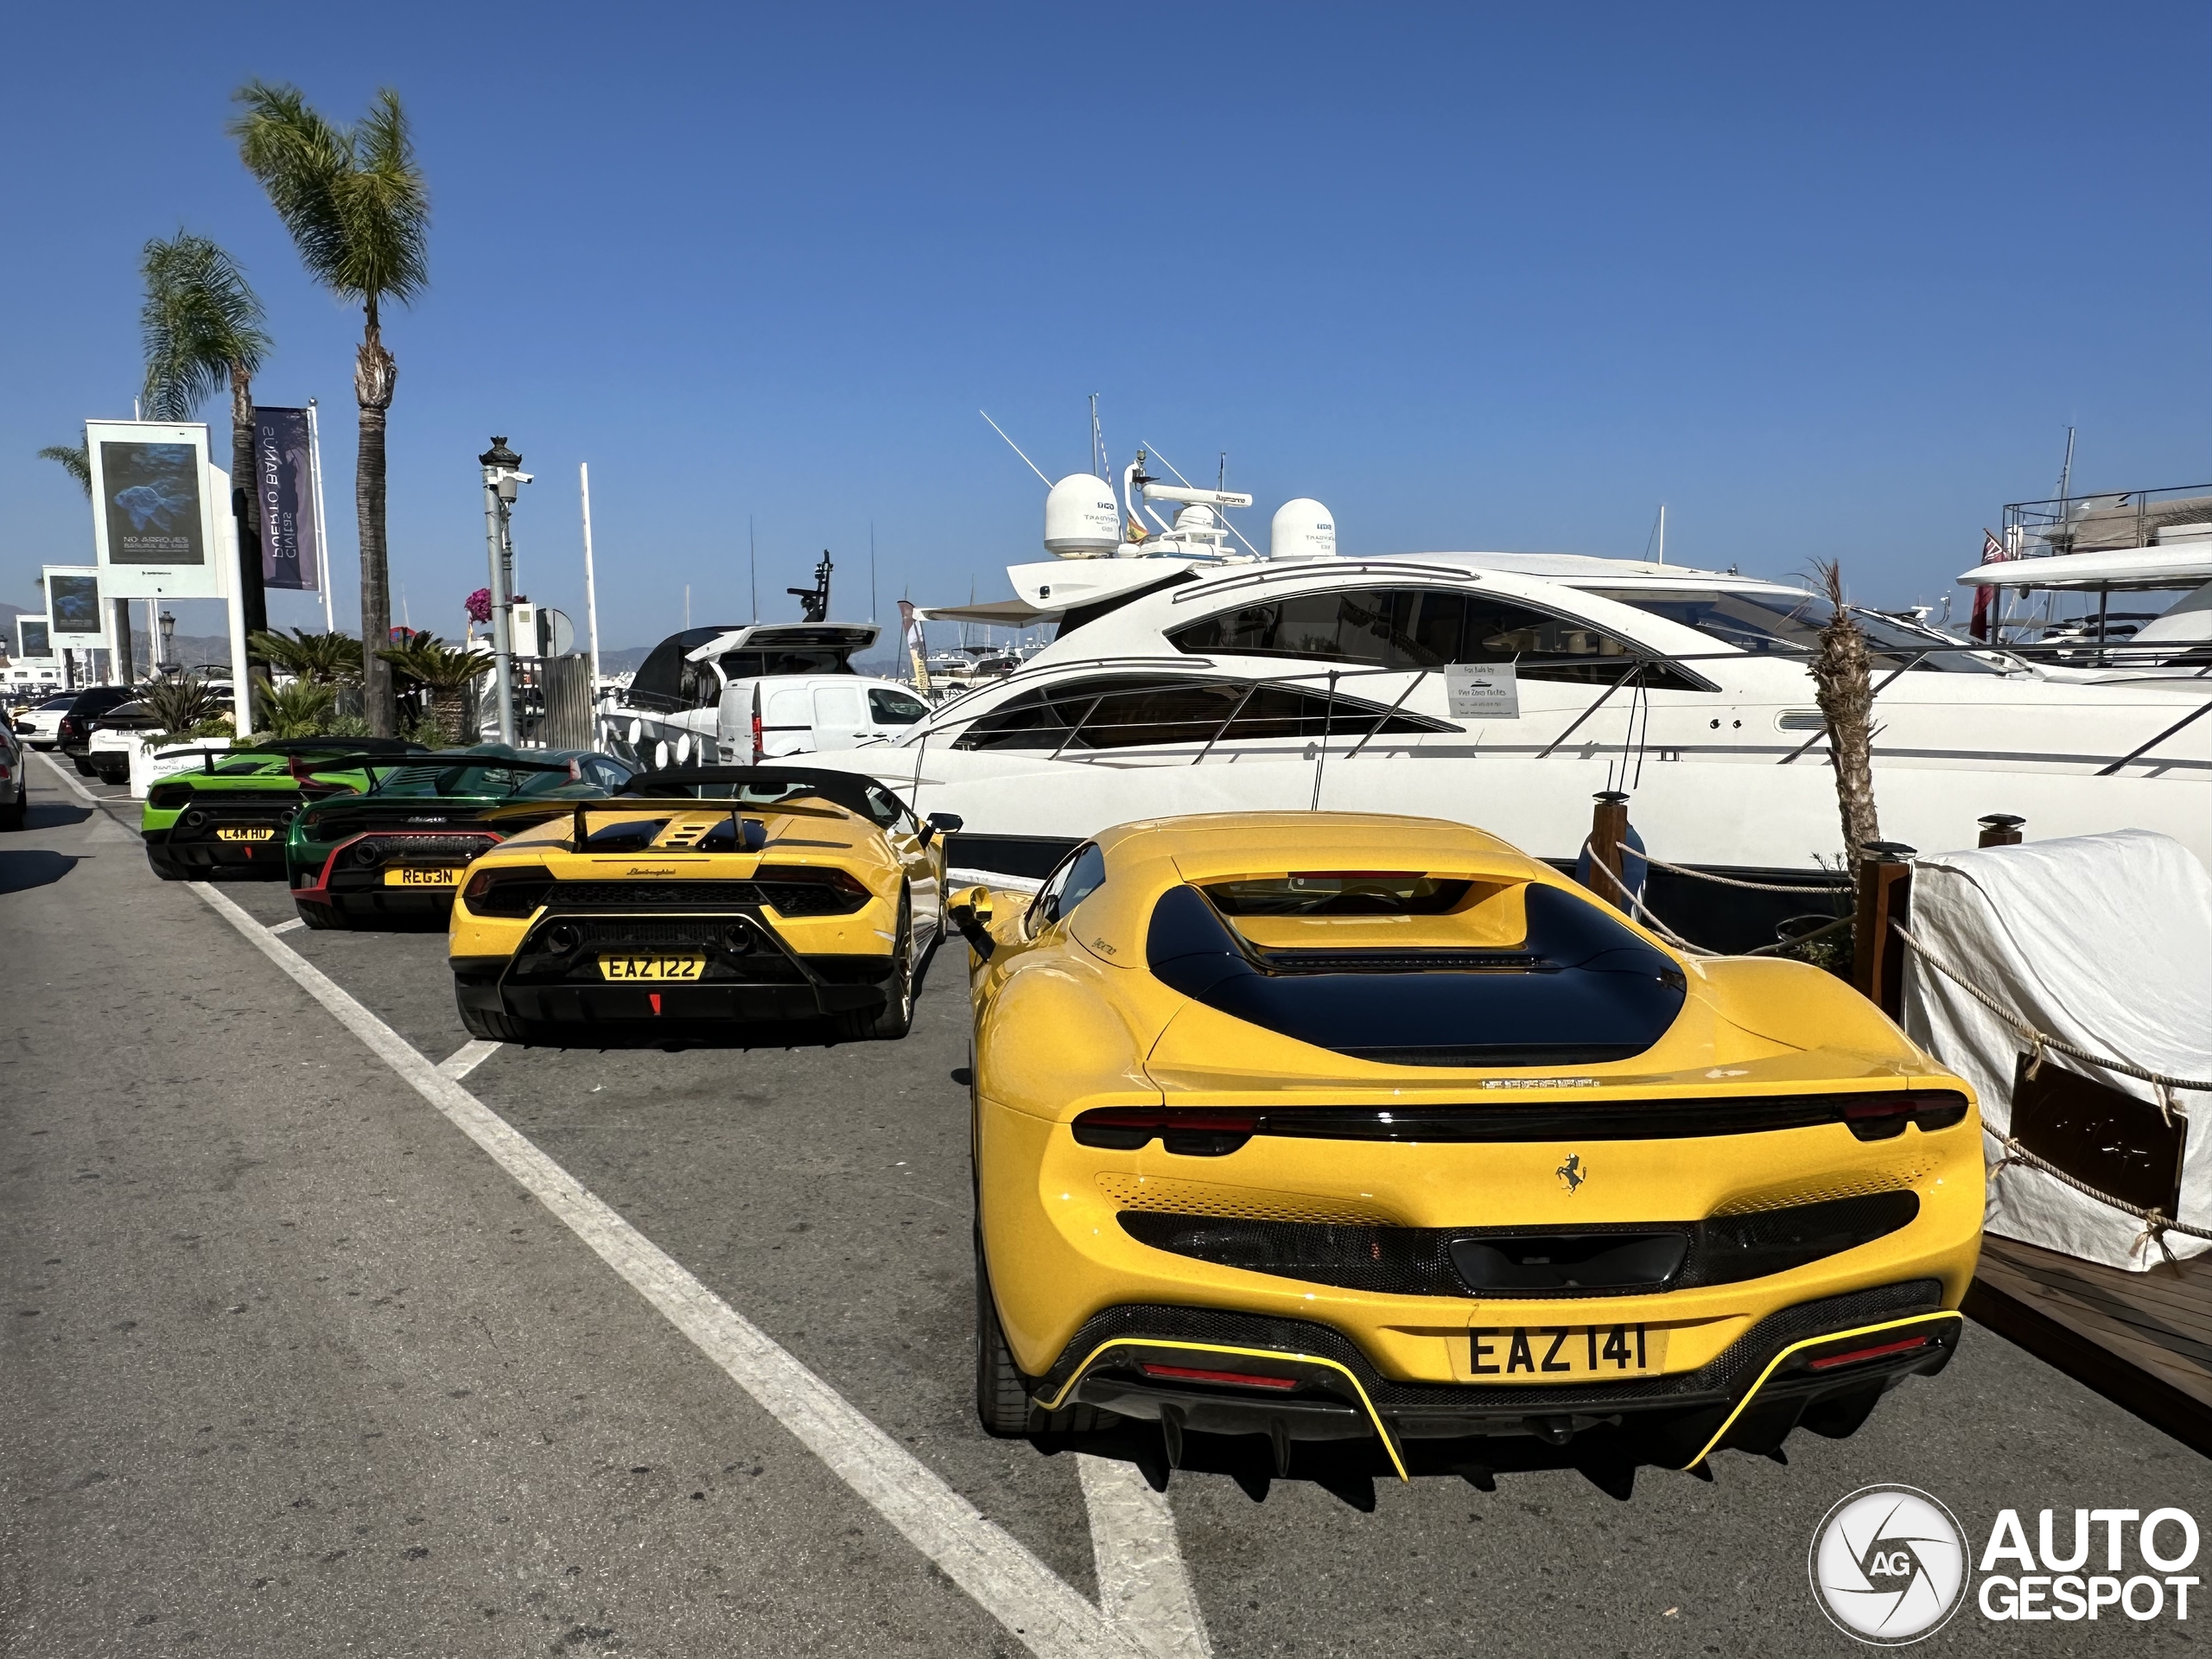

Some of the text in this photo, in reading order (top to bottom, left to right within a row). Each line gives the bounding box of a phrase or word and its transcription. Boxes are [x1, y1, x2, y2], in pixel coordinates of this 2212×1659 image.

[403, 869, 453, 884] REG3N
[609, 957, 695, 977] EAZ 122
[1469, 1323, 1647, 1375] EAZ 141
